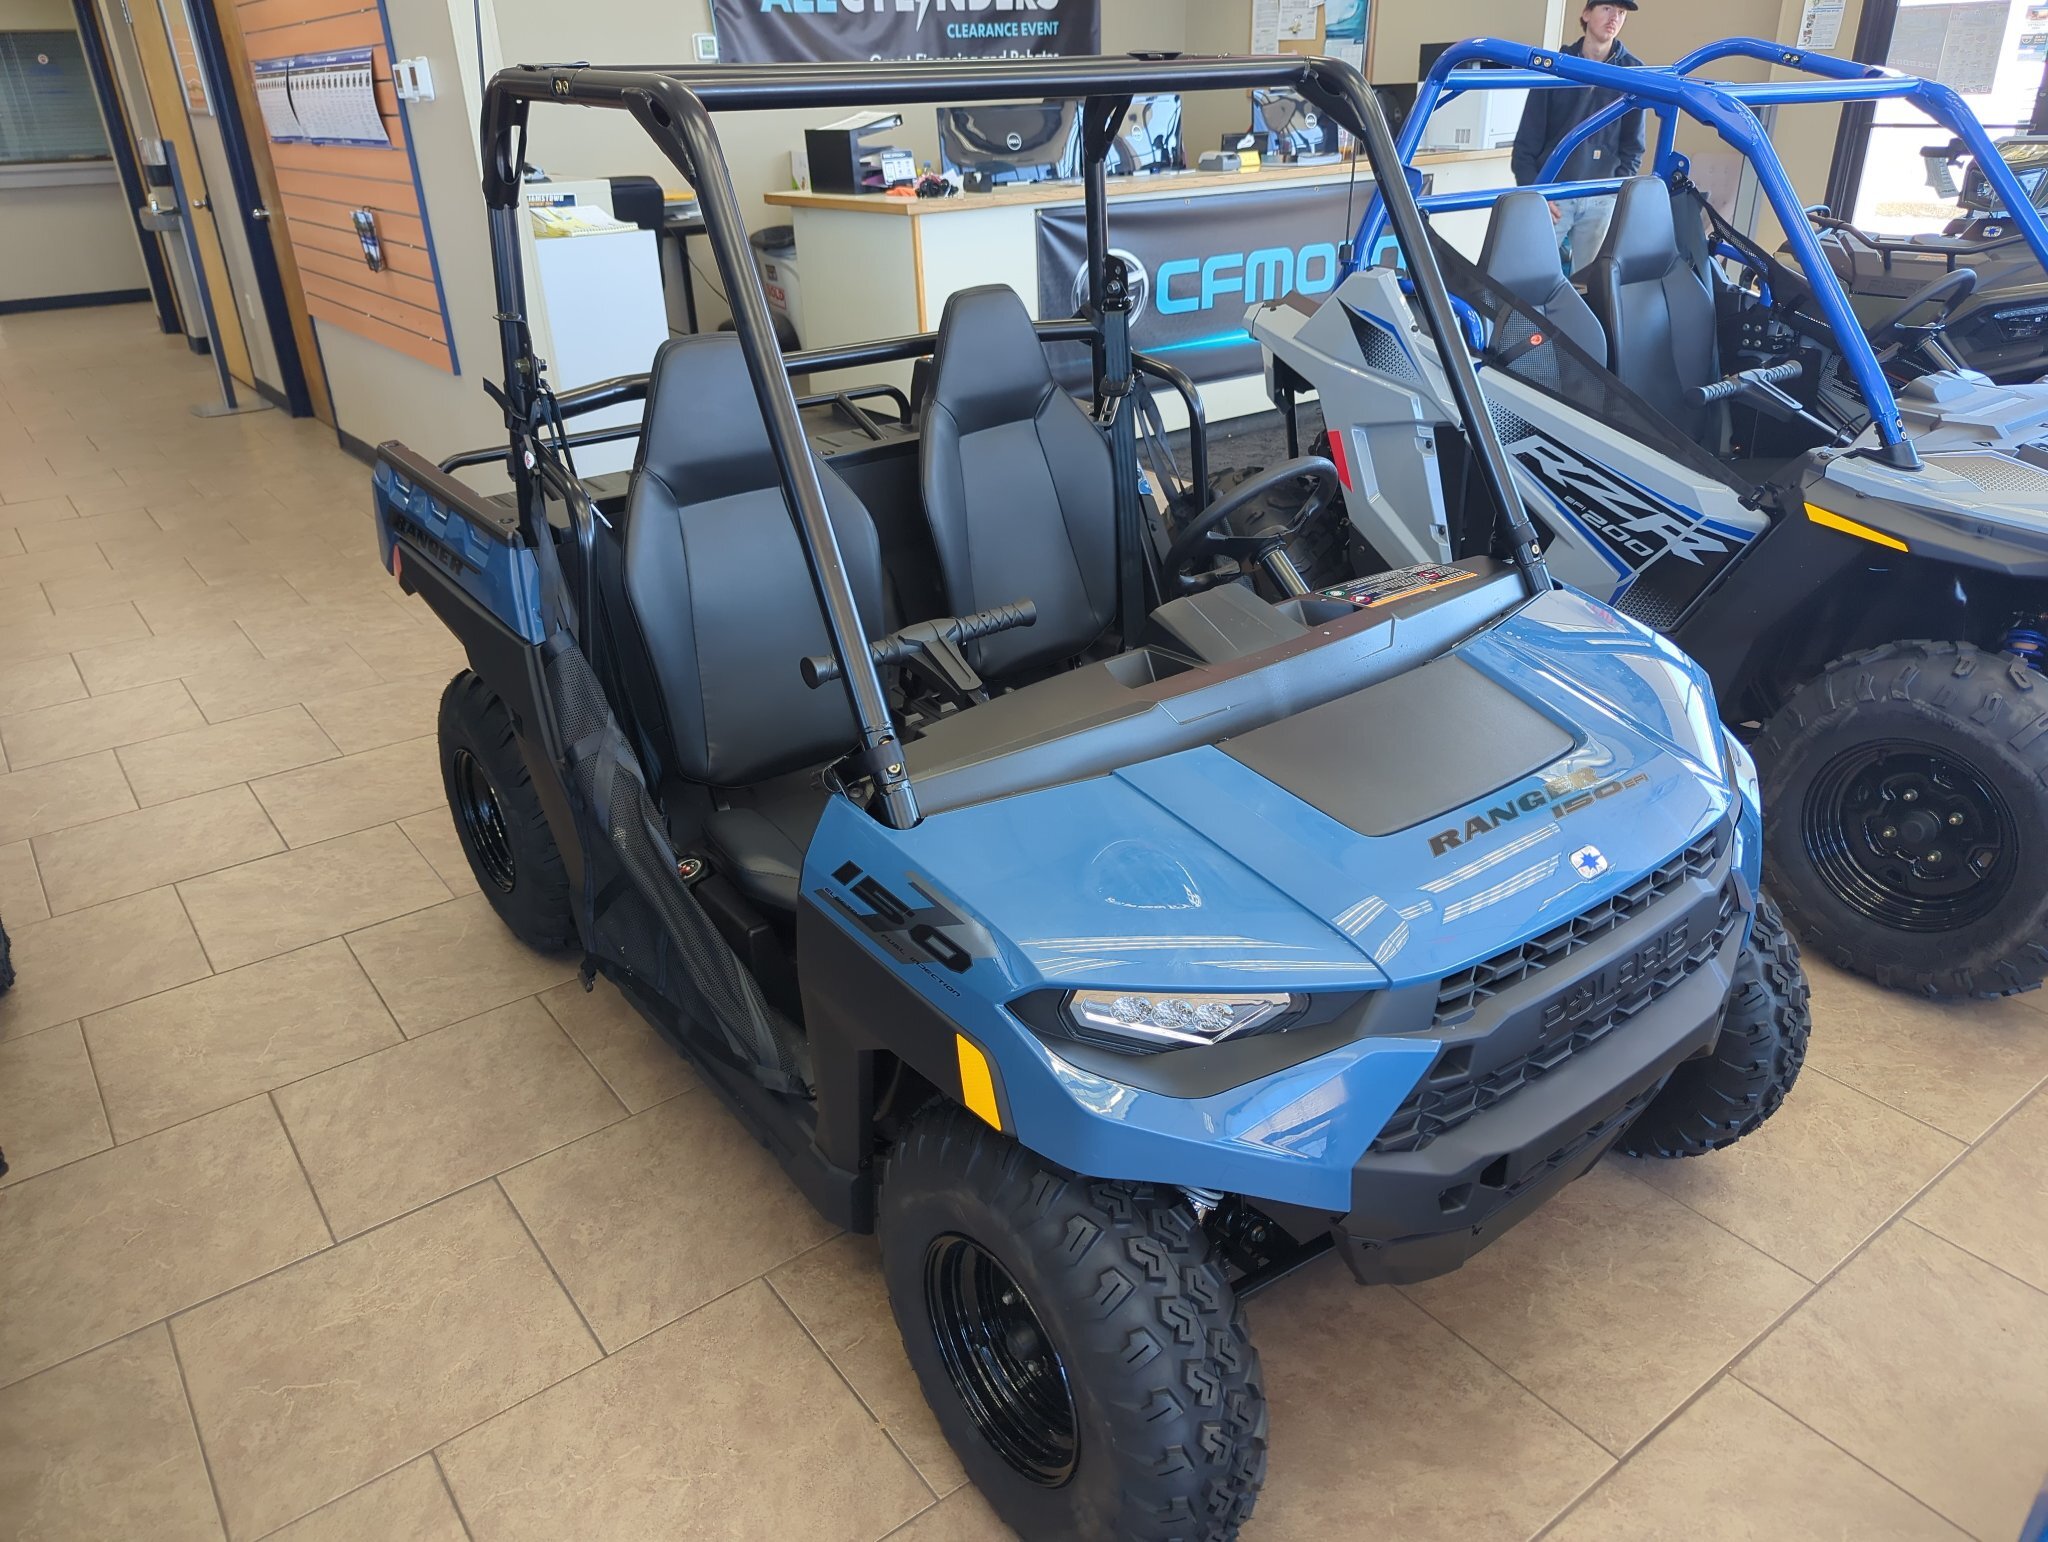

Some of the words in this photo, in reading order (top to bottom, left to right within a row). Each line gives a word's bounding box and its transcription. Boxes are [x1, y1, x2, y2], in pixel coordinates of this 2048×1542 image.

[946, 22, 1019, 39] CLEARANCE
[1021, 21, 1059, 36] EVENT
[395, 514, 464, 577] RANGER
[1563, 495, 1587, 512] EFI
[1581, 512, 1655, 557] 200
[1427, 766, 1599, 859] RANGER
[881, 933, 906, 956] FUEL
[909, 956, 962, 998] INJECTION
[1537, 916, 1690, 1040] POLARIS
